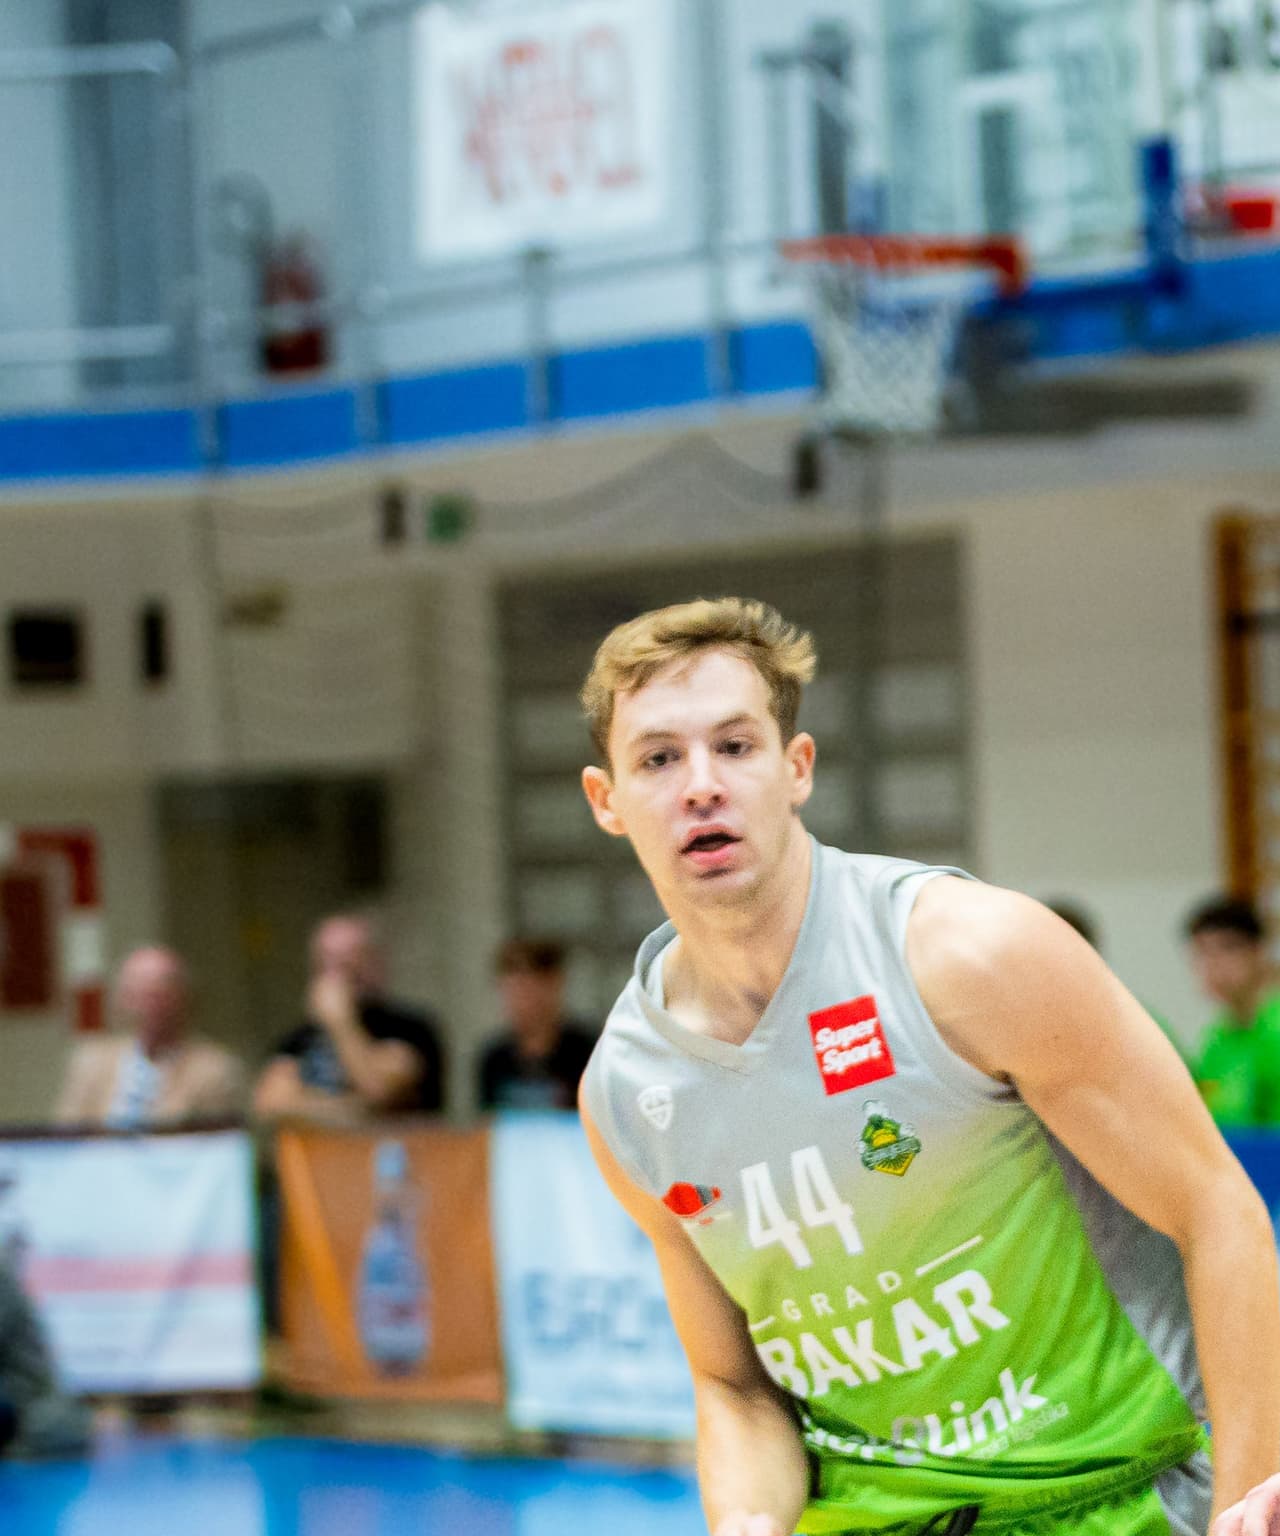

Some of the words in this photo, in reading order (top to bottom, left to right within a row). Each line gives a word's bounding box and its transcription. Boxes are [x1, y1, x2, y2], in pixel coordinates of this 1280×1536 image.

[815, 1017, 879, 1051] Super
[822, 1038, 882, 1074] Sport
[739, 1145, 862, 1270] 44
[781, 1270, 902, 1322] GRAD
[757, 1269, 1010, 1398] BAKAR
